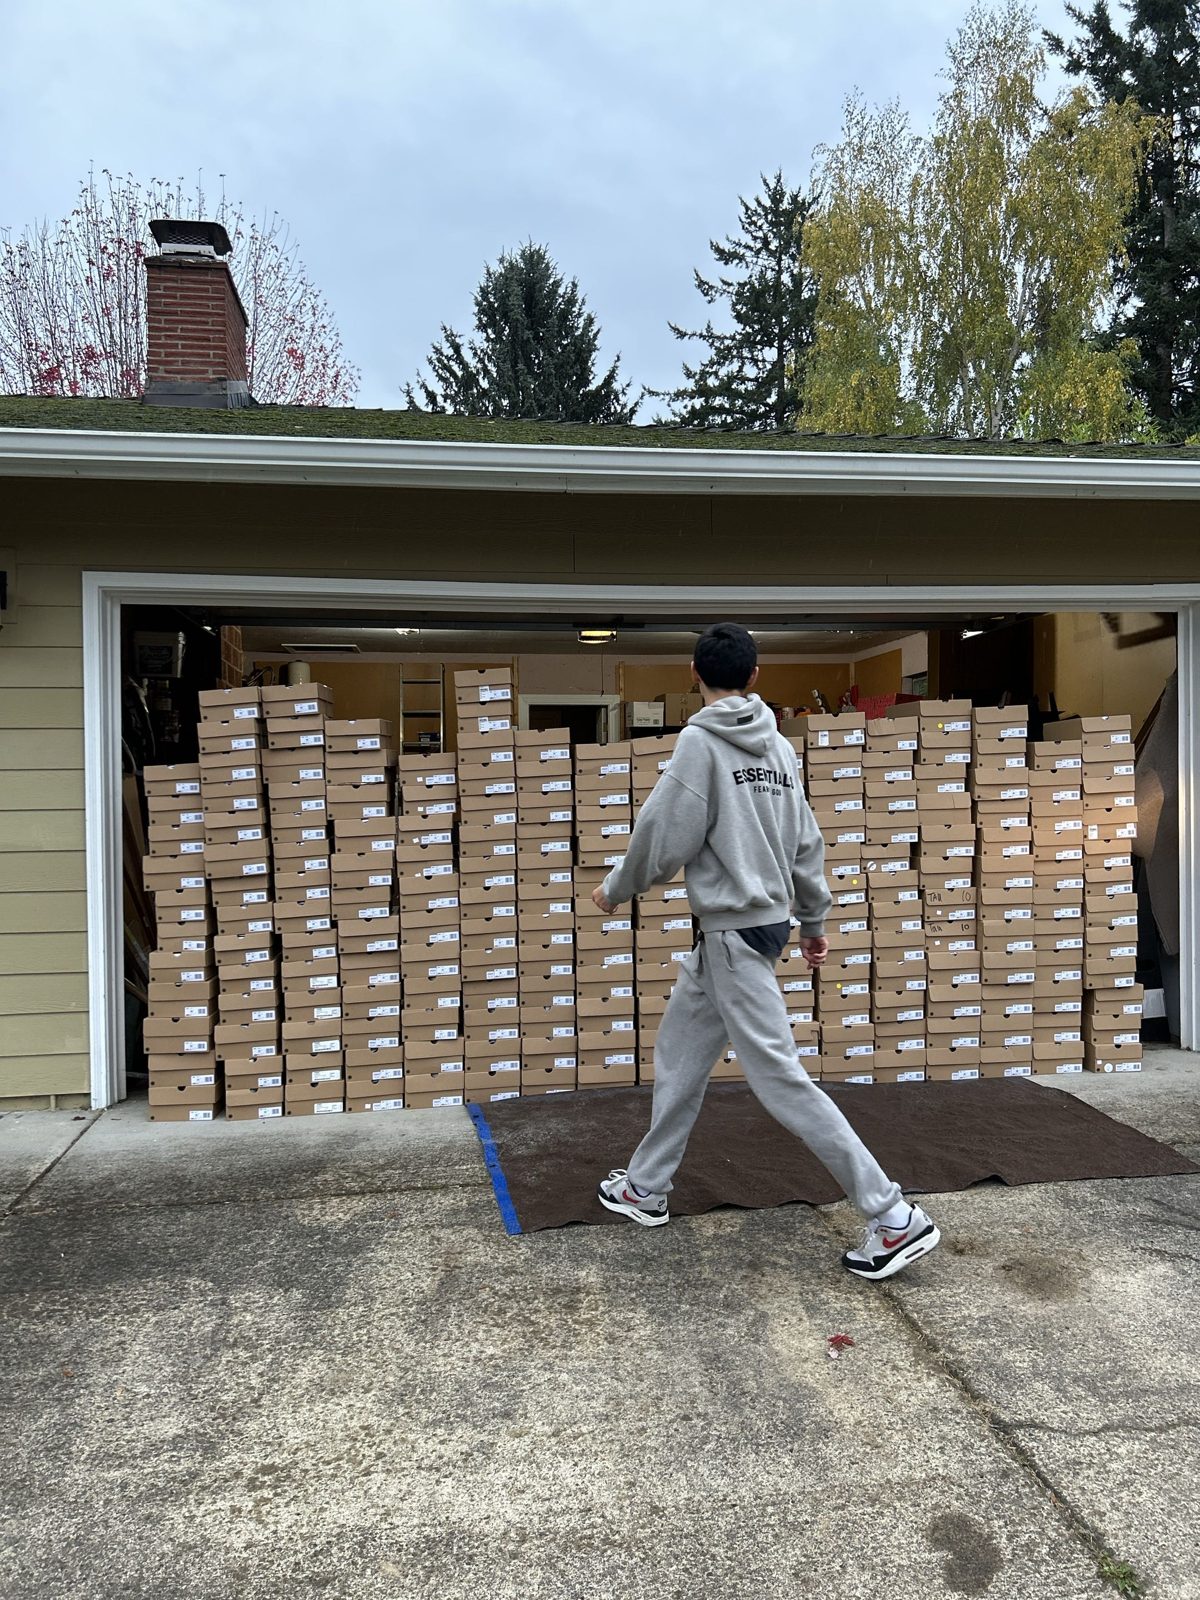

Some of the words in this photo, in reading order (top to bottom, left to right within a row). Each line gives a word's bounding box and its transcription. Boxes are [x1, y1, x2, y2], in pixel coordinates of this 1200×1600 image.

[732, 767, 794, 790] ESSETIAL
[961, 890, 971, 902] 10
[961, 923, 970, 932] 10
